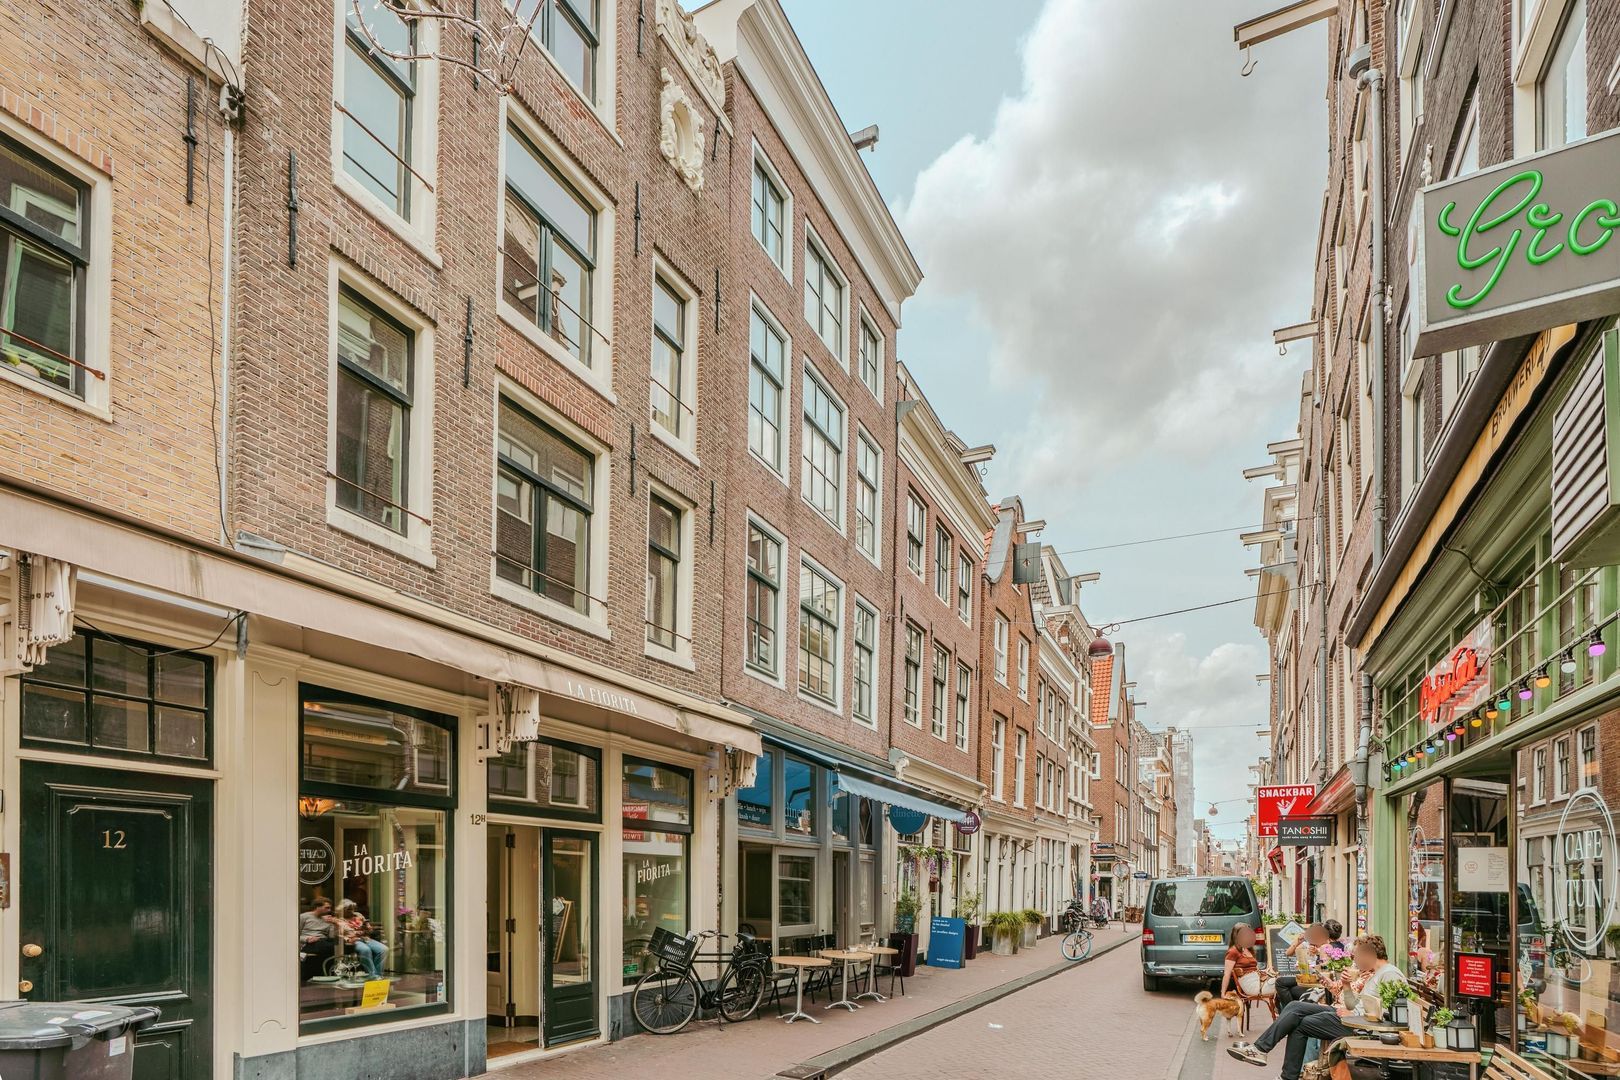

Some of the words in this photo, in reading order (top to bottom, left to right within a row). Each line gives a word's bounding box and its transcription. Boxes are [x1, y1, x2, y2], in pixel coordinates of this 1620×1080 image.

[568, 681, 585, 699] LA
[589, 687, 638, 714] FIORITA
[1259, 787, 1313, 798] SNACKBAR
[102, 830, 127, 849] 12
[1282, 826, 1327, 835] TANOSHII
[354, 843, 368, 857] LA
[1565, 828, 1603, 860] CAFE
[342, 850, 413, 880] FIORITA
[637, 863, 671, 884] FIORITA
[642, 859, 650, 868] LA
[1566, 879, 1602, 907] TUIN
